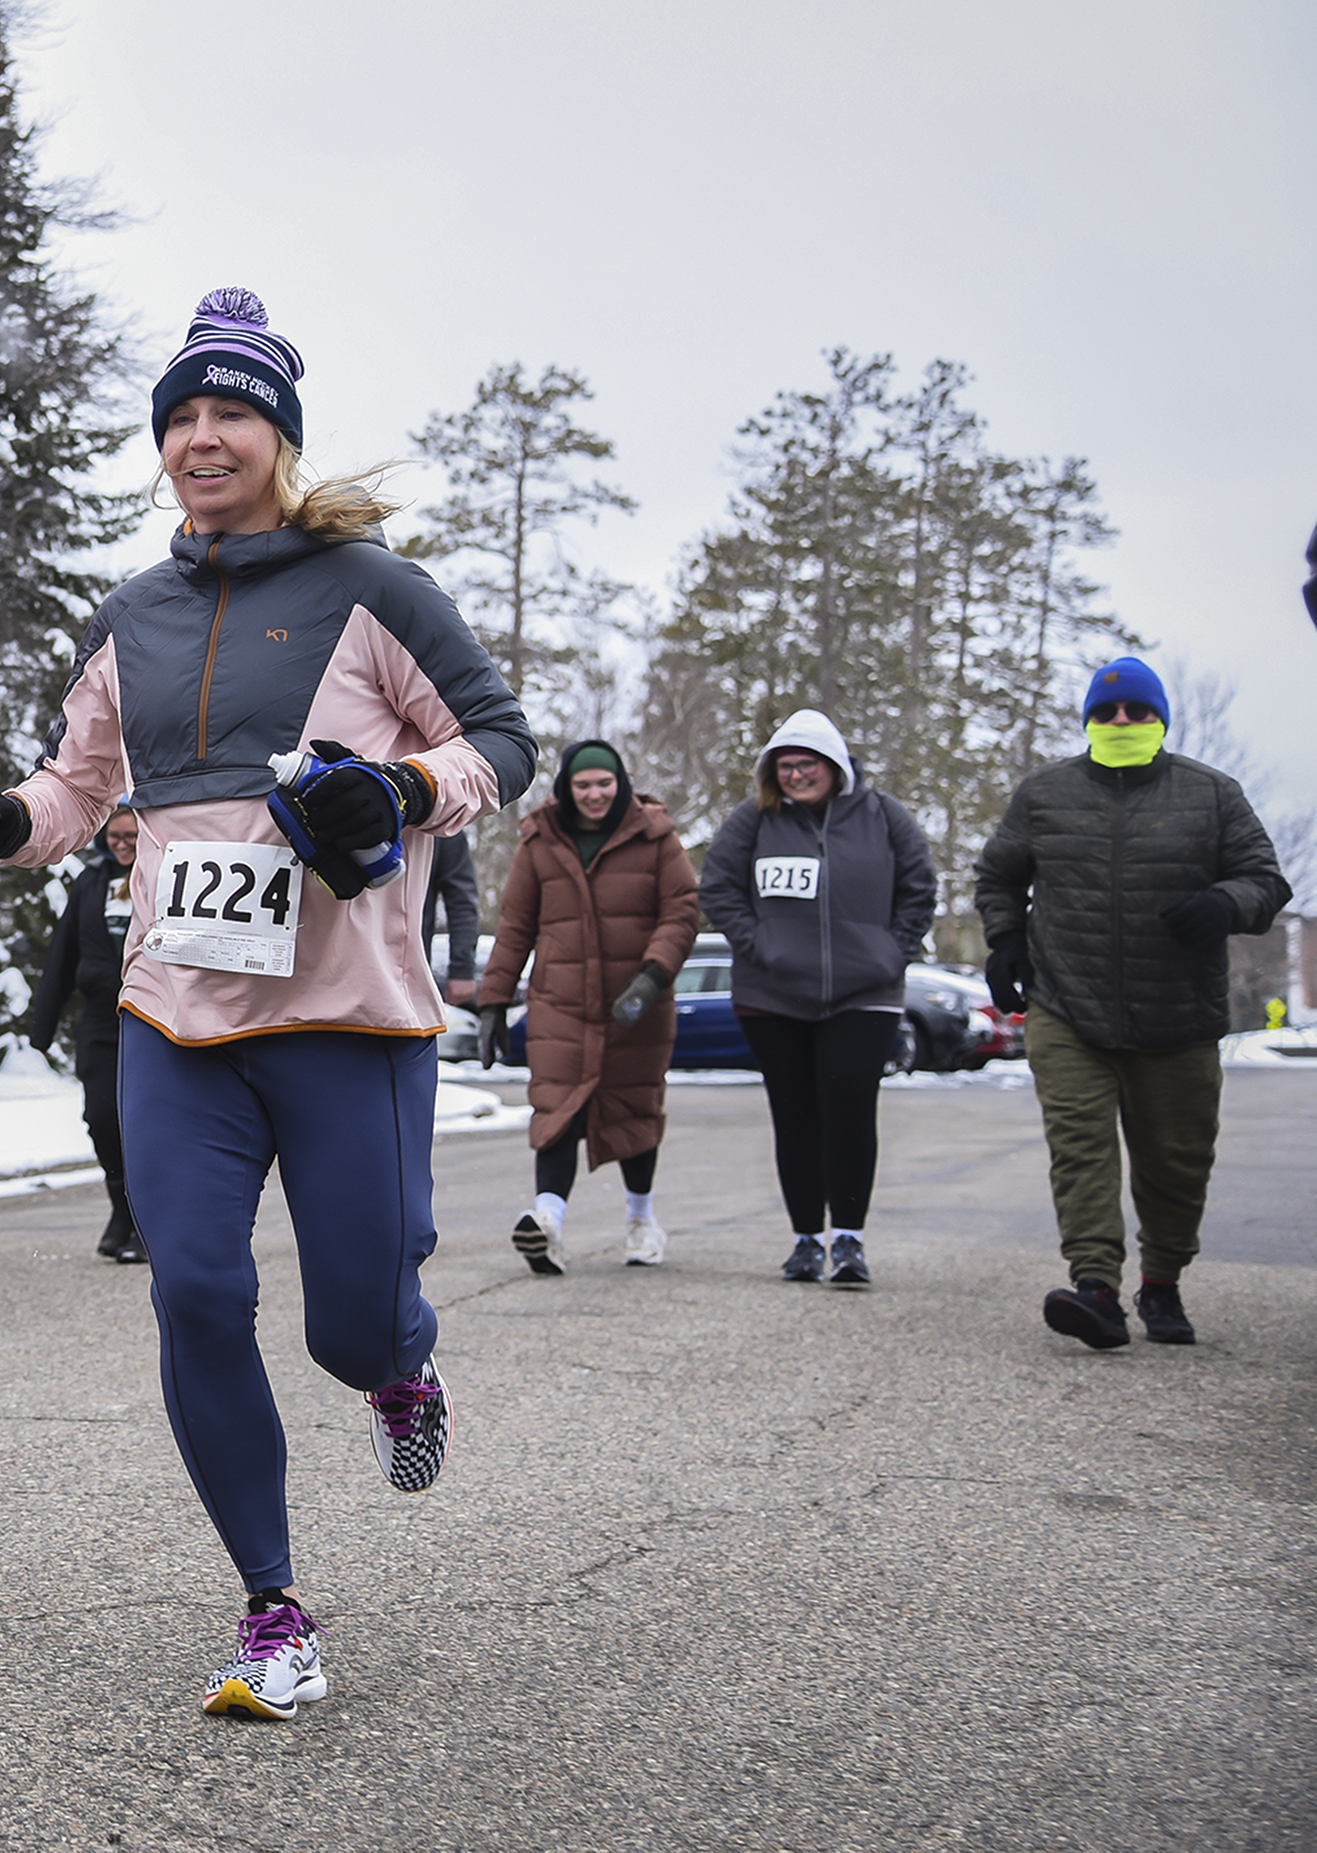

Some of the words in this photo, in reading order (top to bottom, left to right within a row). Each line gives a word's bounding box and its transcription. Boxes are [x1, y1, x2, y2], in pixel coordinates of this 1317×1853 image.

[214, 371, 247, 390] FIGHTS
[249, 381, 279, 408] CANCER
[167, 861, 291, 925] 1224
[761, 867, 812, 891] 1215
